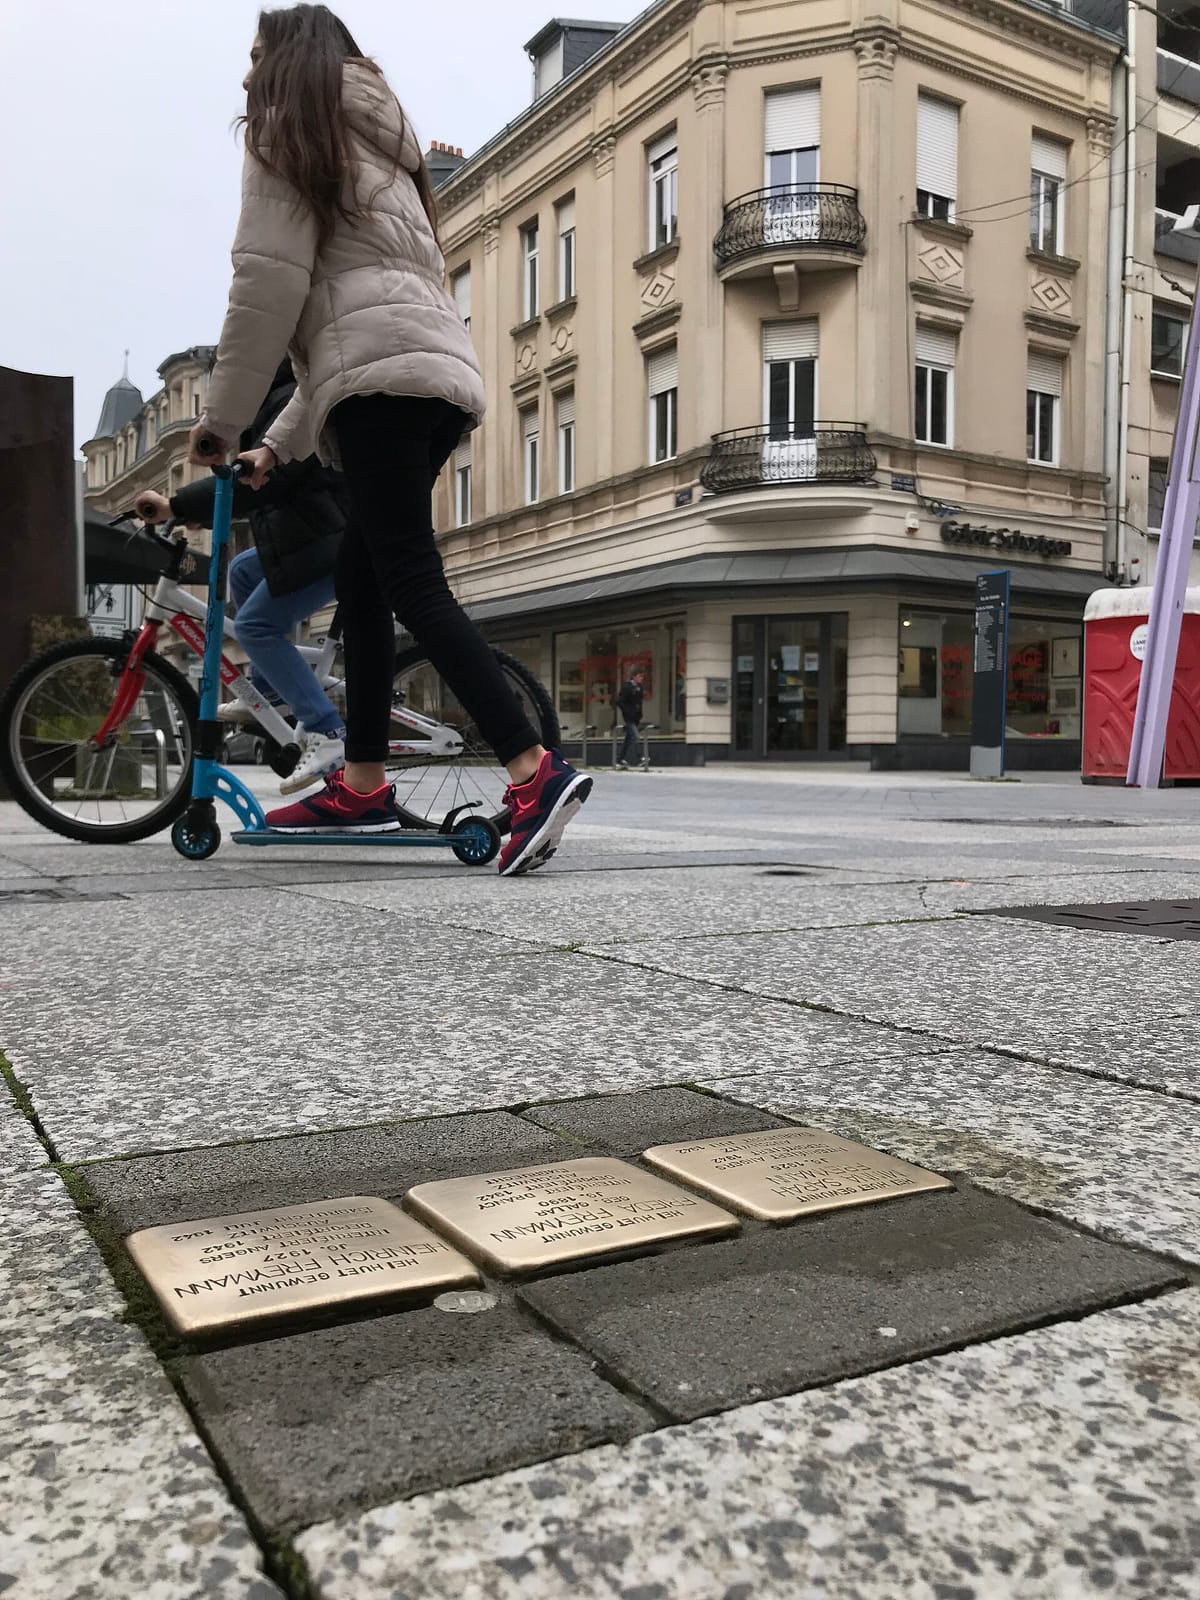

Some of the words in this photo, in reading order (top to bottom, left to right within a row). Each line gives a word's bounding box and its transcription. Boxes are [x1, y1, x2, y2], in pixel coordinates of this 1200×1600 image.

[770, 1178, 842, 1197] SARAH
[857, 1181, 890, 1191] HUET
[478, 1193, 536, 1210] DRANCY
[617, 1197, 697, 1213] FRIEDA
[228, 1219, 328, 1238] AUSCHWITZ
[490, 1208, 614, 1242] FREYMANN
[616, 1214, 656, 1227] HUET
[171, 1230, 214, 1241] 1942
[541, 1222, 613, 1243] GEWUNNT
[199, 1244, 269, 1264] ANGERS
[201, 1241, 244, 1253] 1942
[263, 1249, 311, 1262] 1927
[328, 1243, 448, 1265] HEINRICH
[337, 1263, 384, 1277] HUET
[386, 1258, 419, 1269] HEI
[174, 1258, 322, 1298] FREYMANN
[239, 1272, 330, 1296] GEWUNNT
